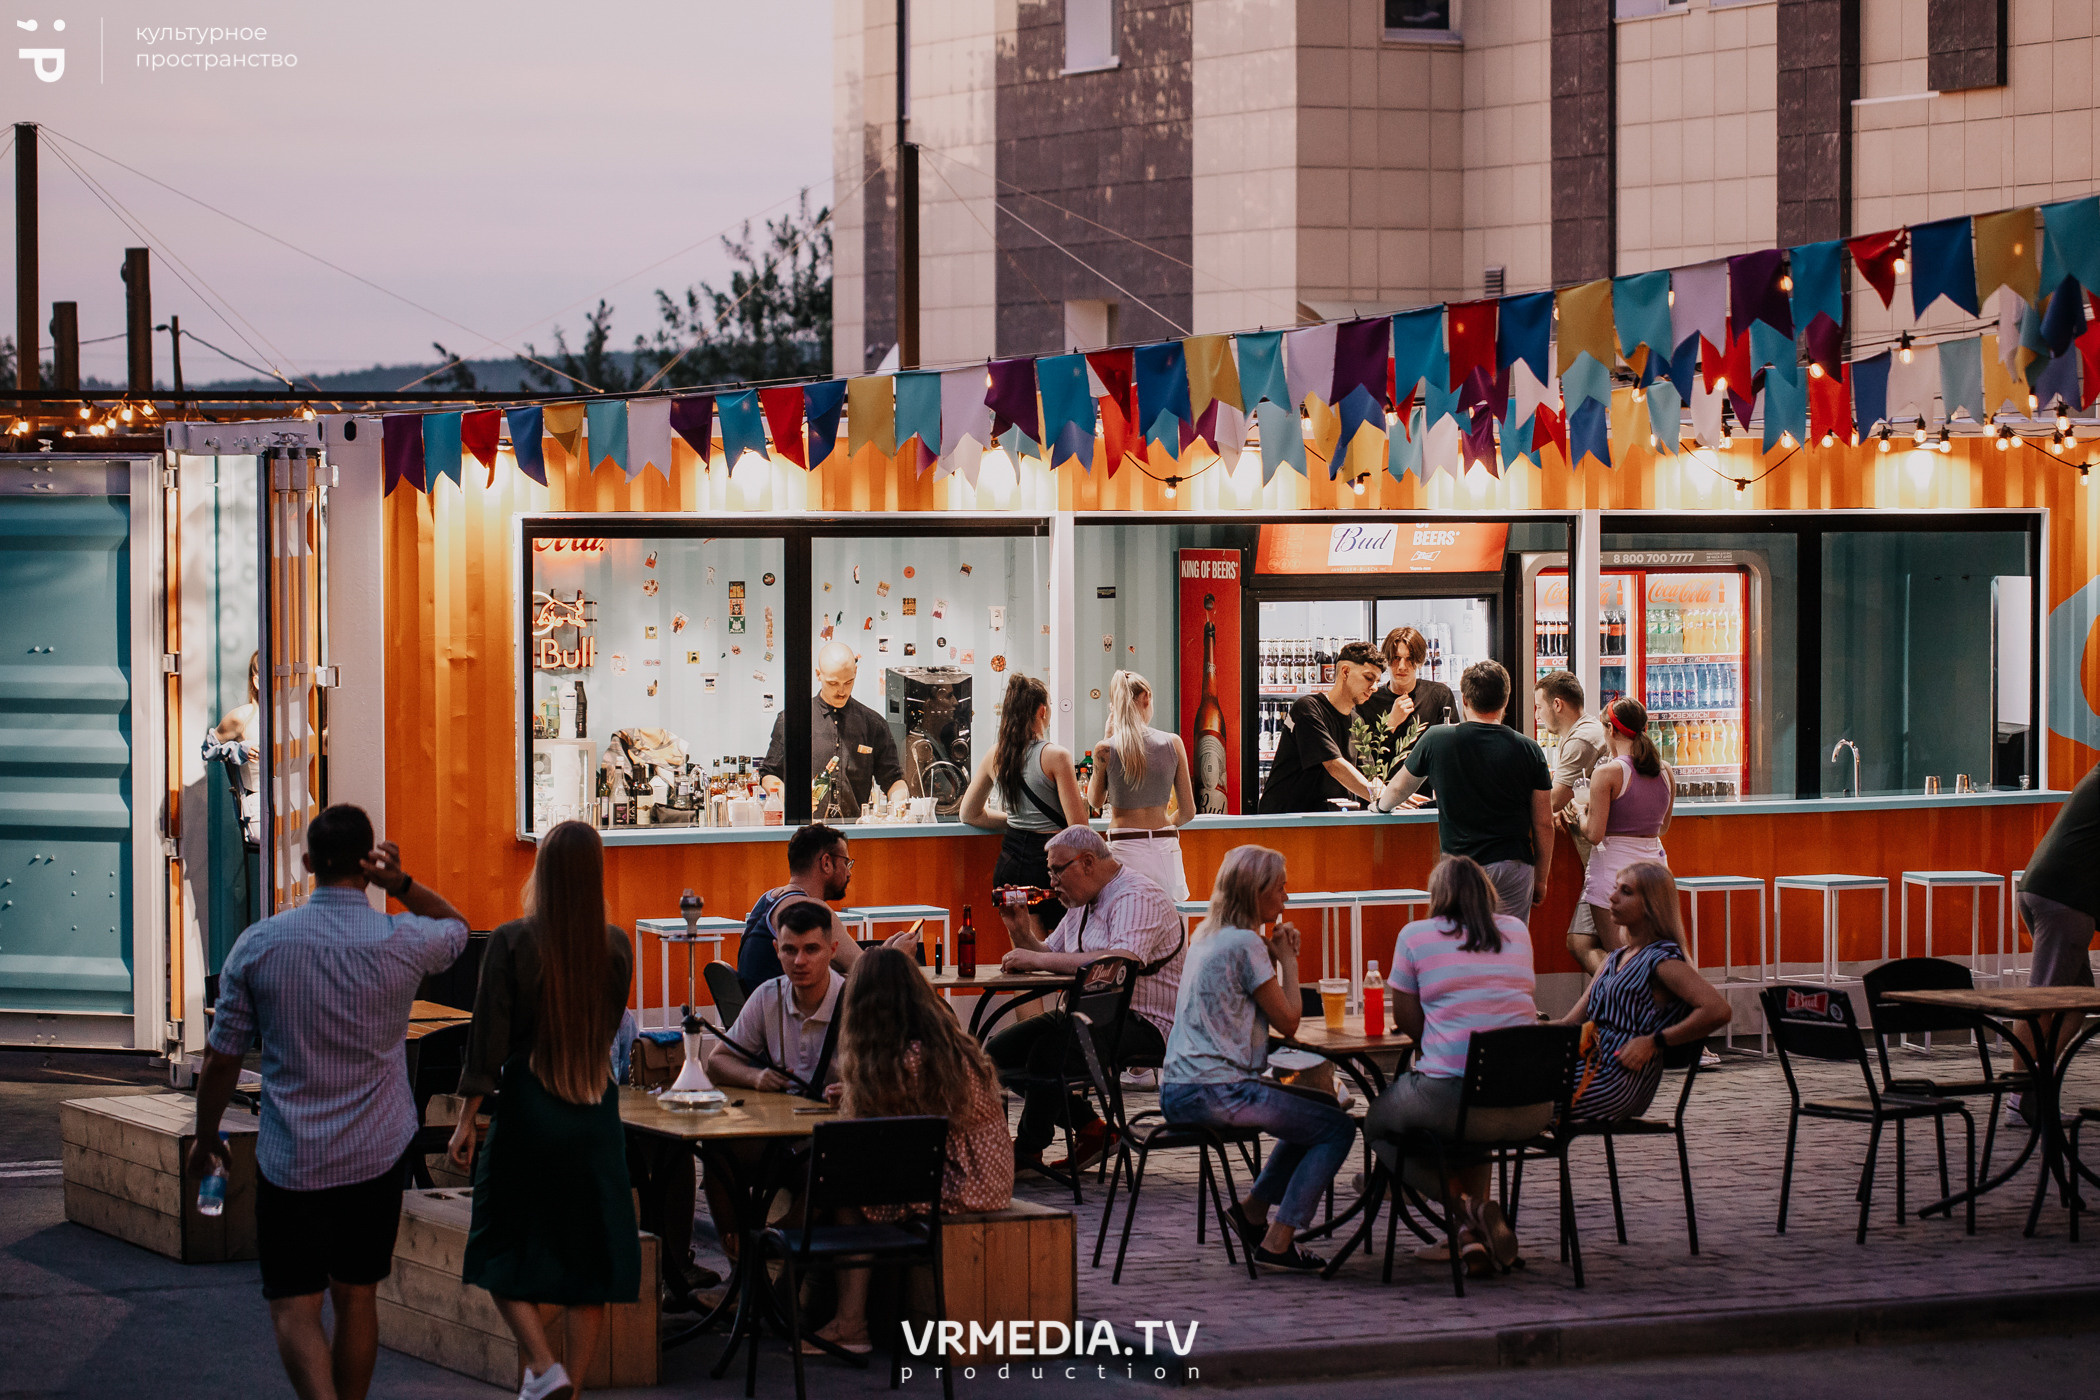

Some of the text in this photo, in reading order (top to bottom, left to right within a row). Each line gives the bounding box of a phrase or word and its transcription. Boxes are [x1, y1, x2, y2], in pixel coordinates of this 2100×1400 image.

[1333, 526, 1392, 553] Bud
[1181, 560, 1200, 578] KING
[1200, 560, 1211, 579] OF
[1613, 554, 1621, 564] 8
[1622, 554, 1644, 563] 800
[1646, 553, 1668, 563] 700
[1669, 553, 1695, 562] 7777
[540, 636, 595, 669] Bull
